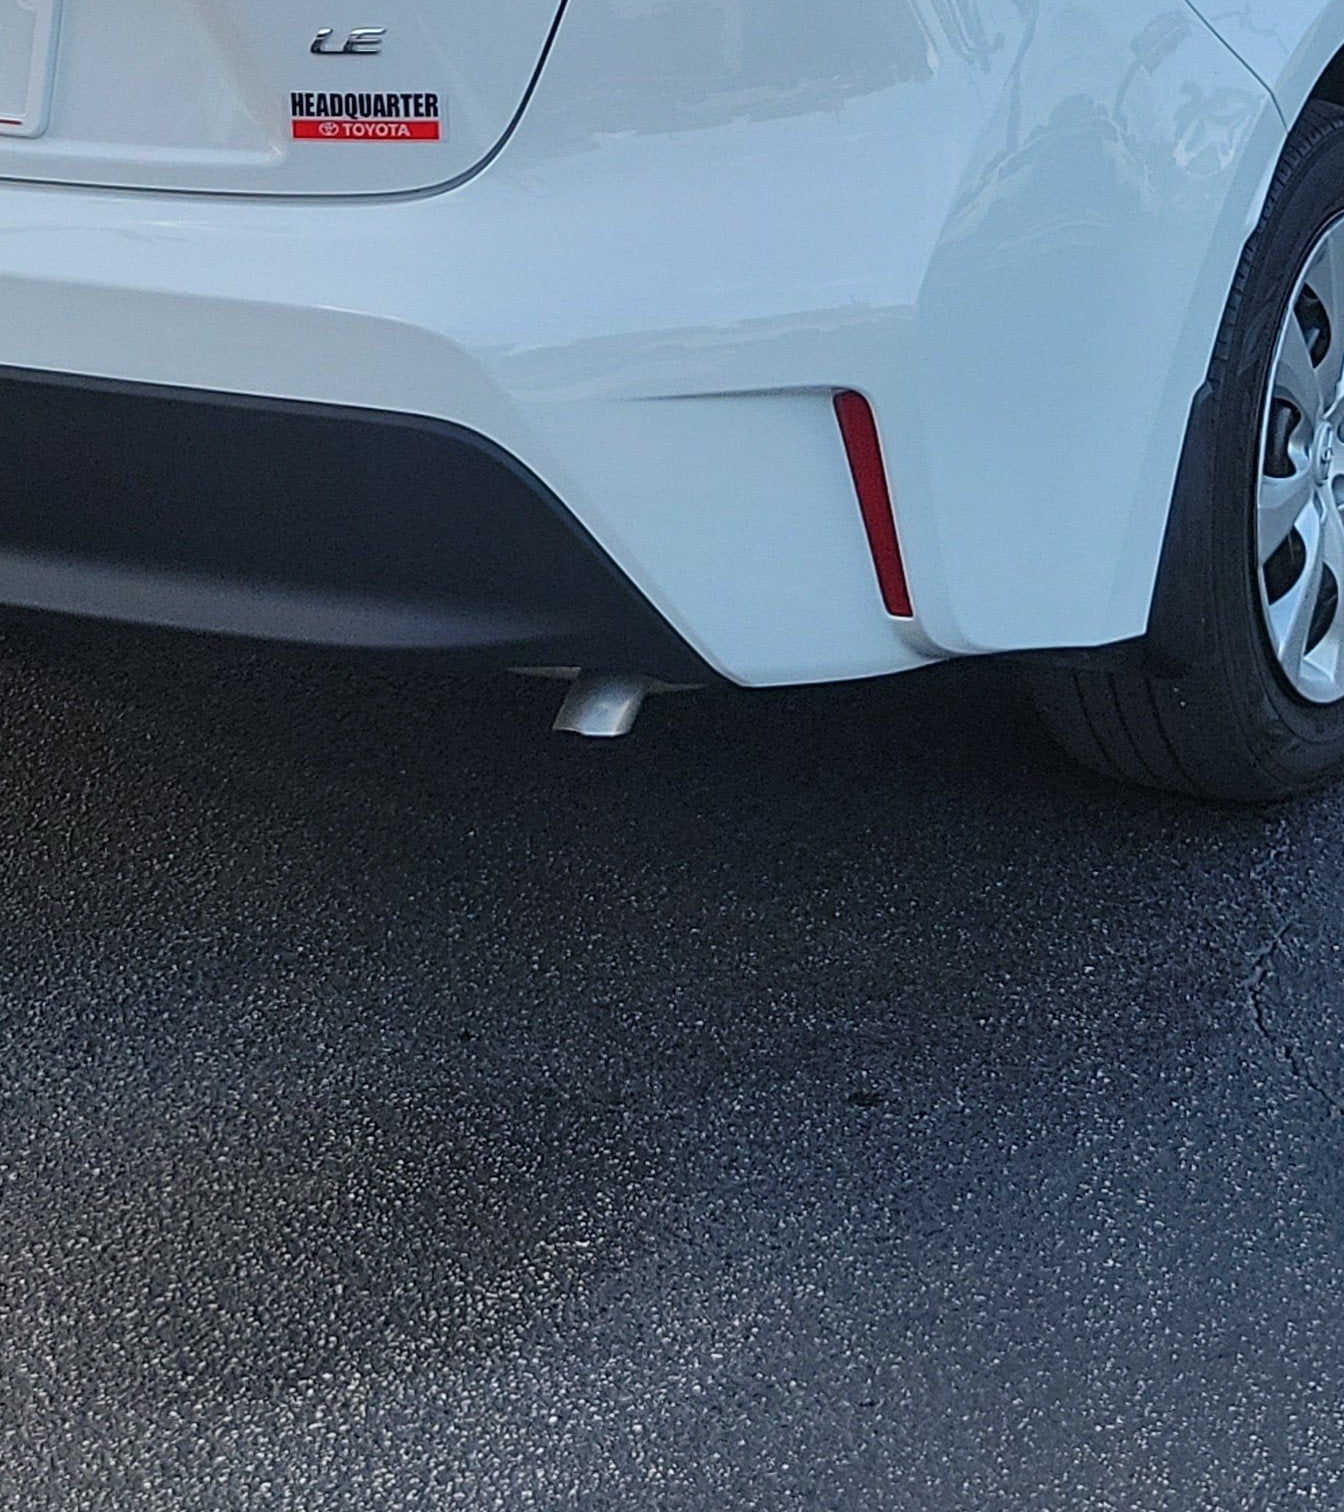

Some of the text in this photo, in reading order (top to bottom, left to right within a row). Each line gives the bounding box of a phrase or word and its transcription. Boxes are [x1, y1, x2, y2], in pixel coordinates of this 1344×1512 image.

[310, 25, 387, 55] LE
[291, 92, 439, 119] HEADQUARTER
[342, 123, 411, 137] TOYOTA
